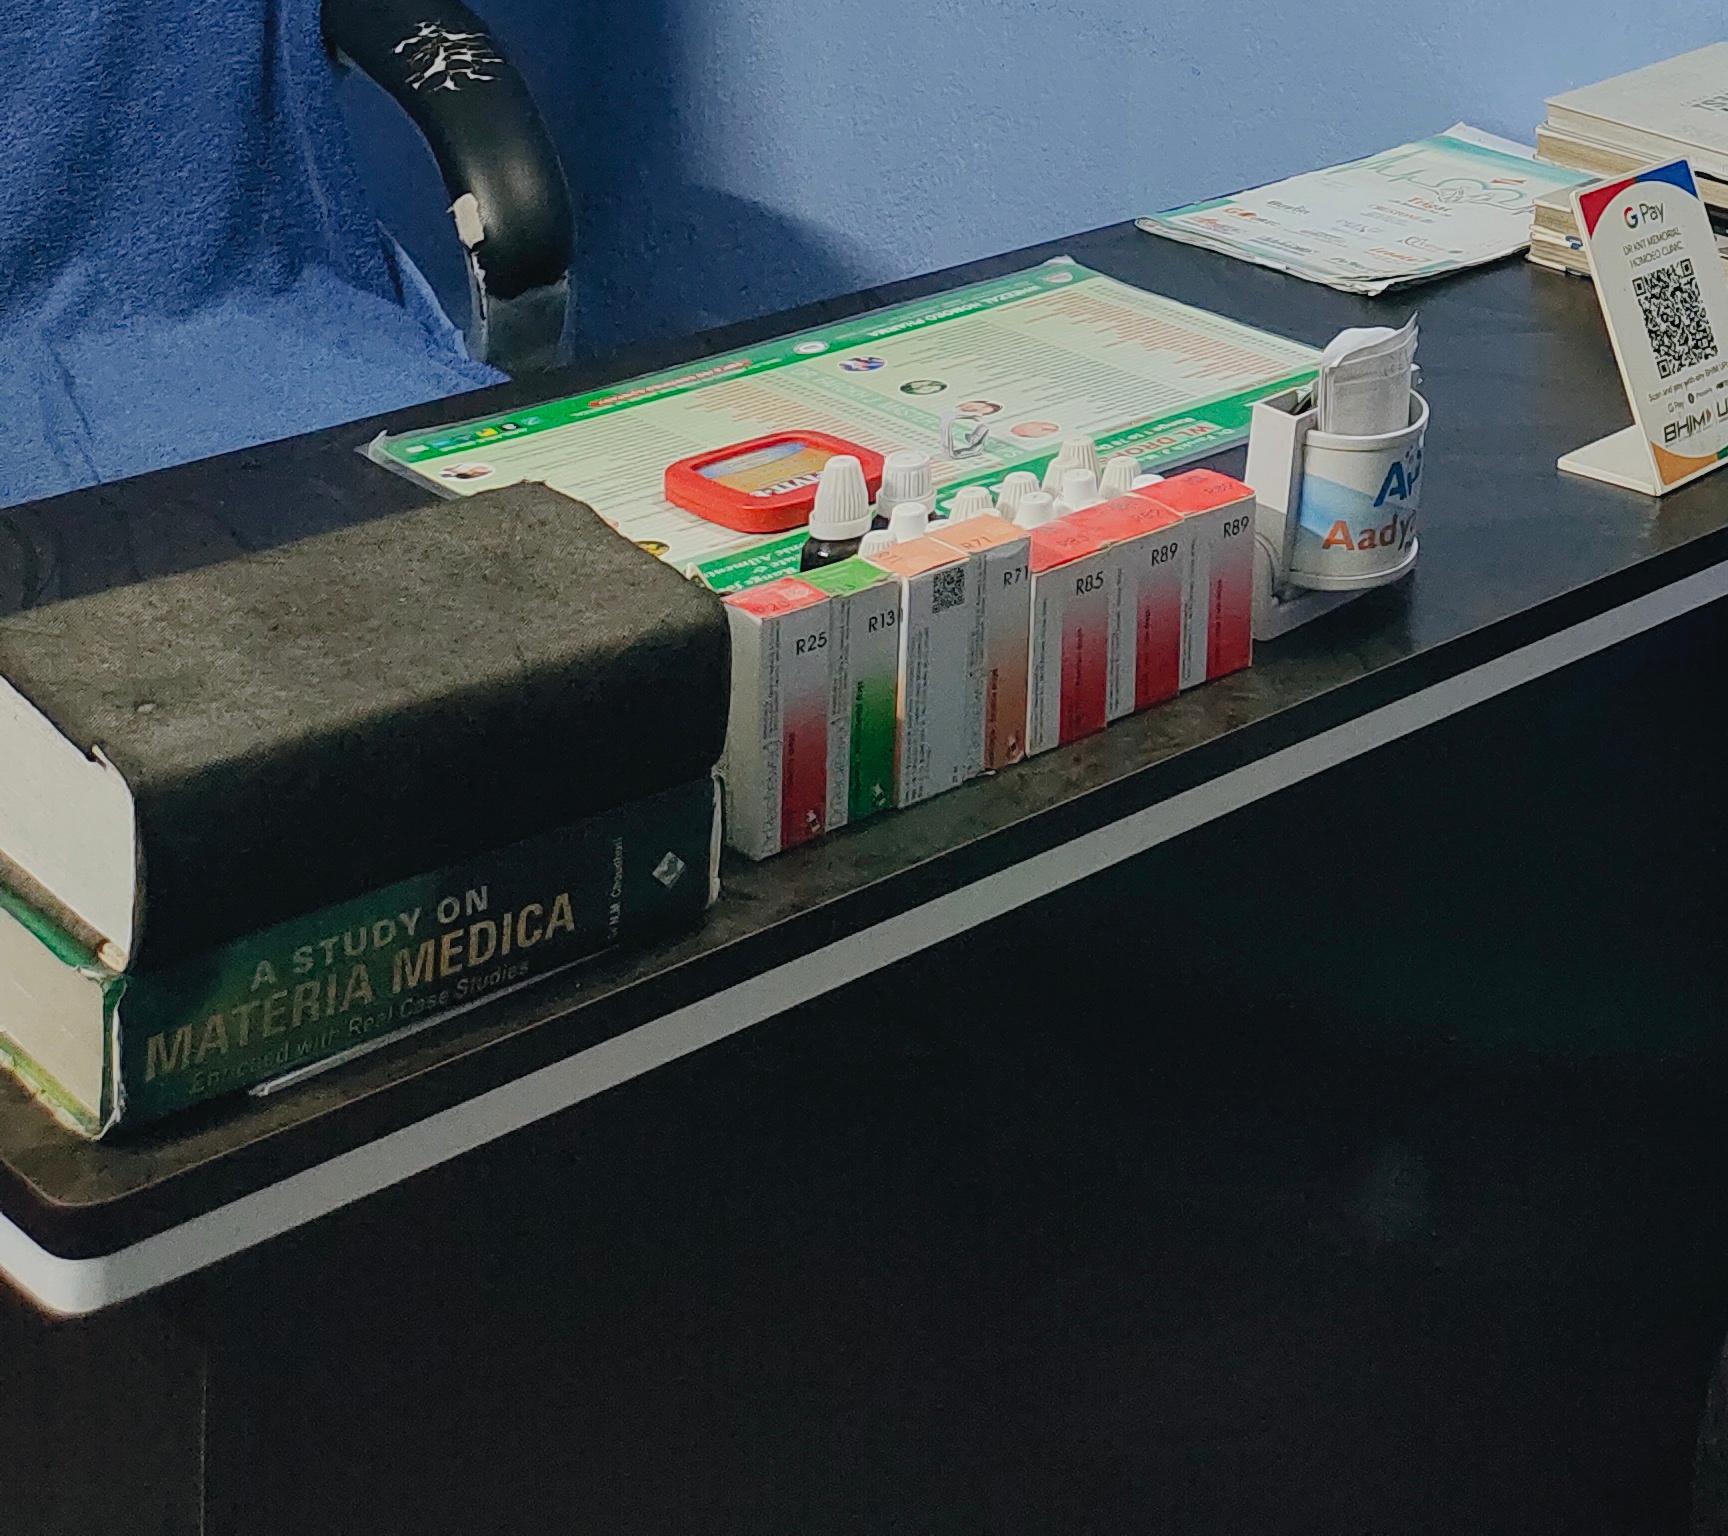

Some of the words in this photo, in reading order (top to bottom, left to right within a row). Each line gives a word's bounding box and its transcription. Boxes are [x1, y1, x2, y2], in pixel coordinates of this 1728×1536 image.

[1624, 207, 1638, 228] G
[1639, 202, 1664, 224] Pay
[1664, 411, 1706, 442] BHIM
[1224, 516, 1250, 538] R89
[1152, 542, 1178, 567] R89
[1004, 565, 1028, 587] R71
[1076, 571, 1104, 596] R85
[868, 610, 896, 632] R13
[796, 631, 828, 656] R25
[251, 960, 276, 992] A
[293, 907, 421, 974] STUDY
[437, 885, 489, 924] ON
[146, 963, 375, 1083] MATERIA
[392, 892, 575, 994] MEDICA
[401, 990, 449, 1016] Case
[455, 960, 530, 1000] Studies
